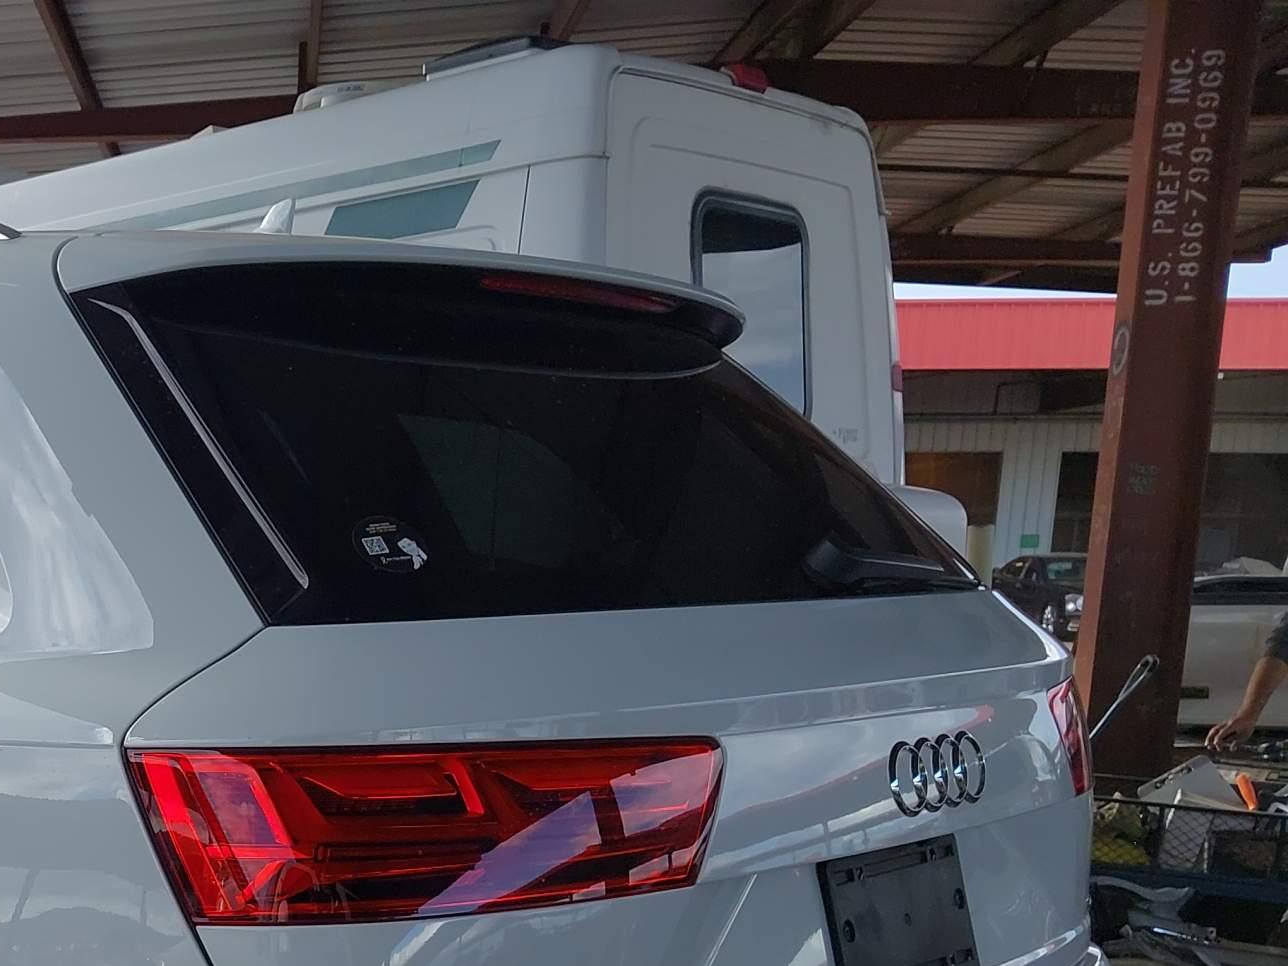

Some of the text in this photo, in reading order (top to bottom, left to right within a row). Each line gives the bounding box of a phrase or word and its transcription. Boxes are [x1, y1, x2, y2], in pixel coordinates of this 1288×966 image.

[1144, 48, 1196, 306] U.S. PREFAB INC.
[1174, 49, 1226, 302] 1-866-799-0969
